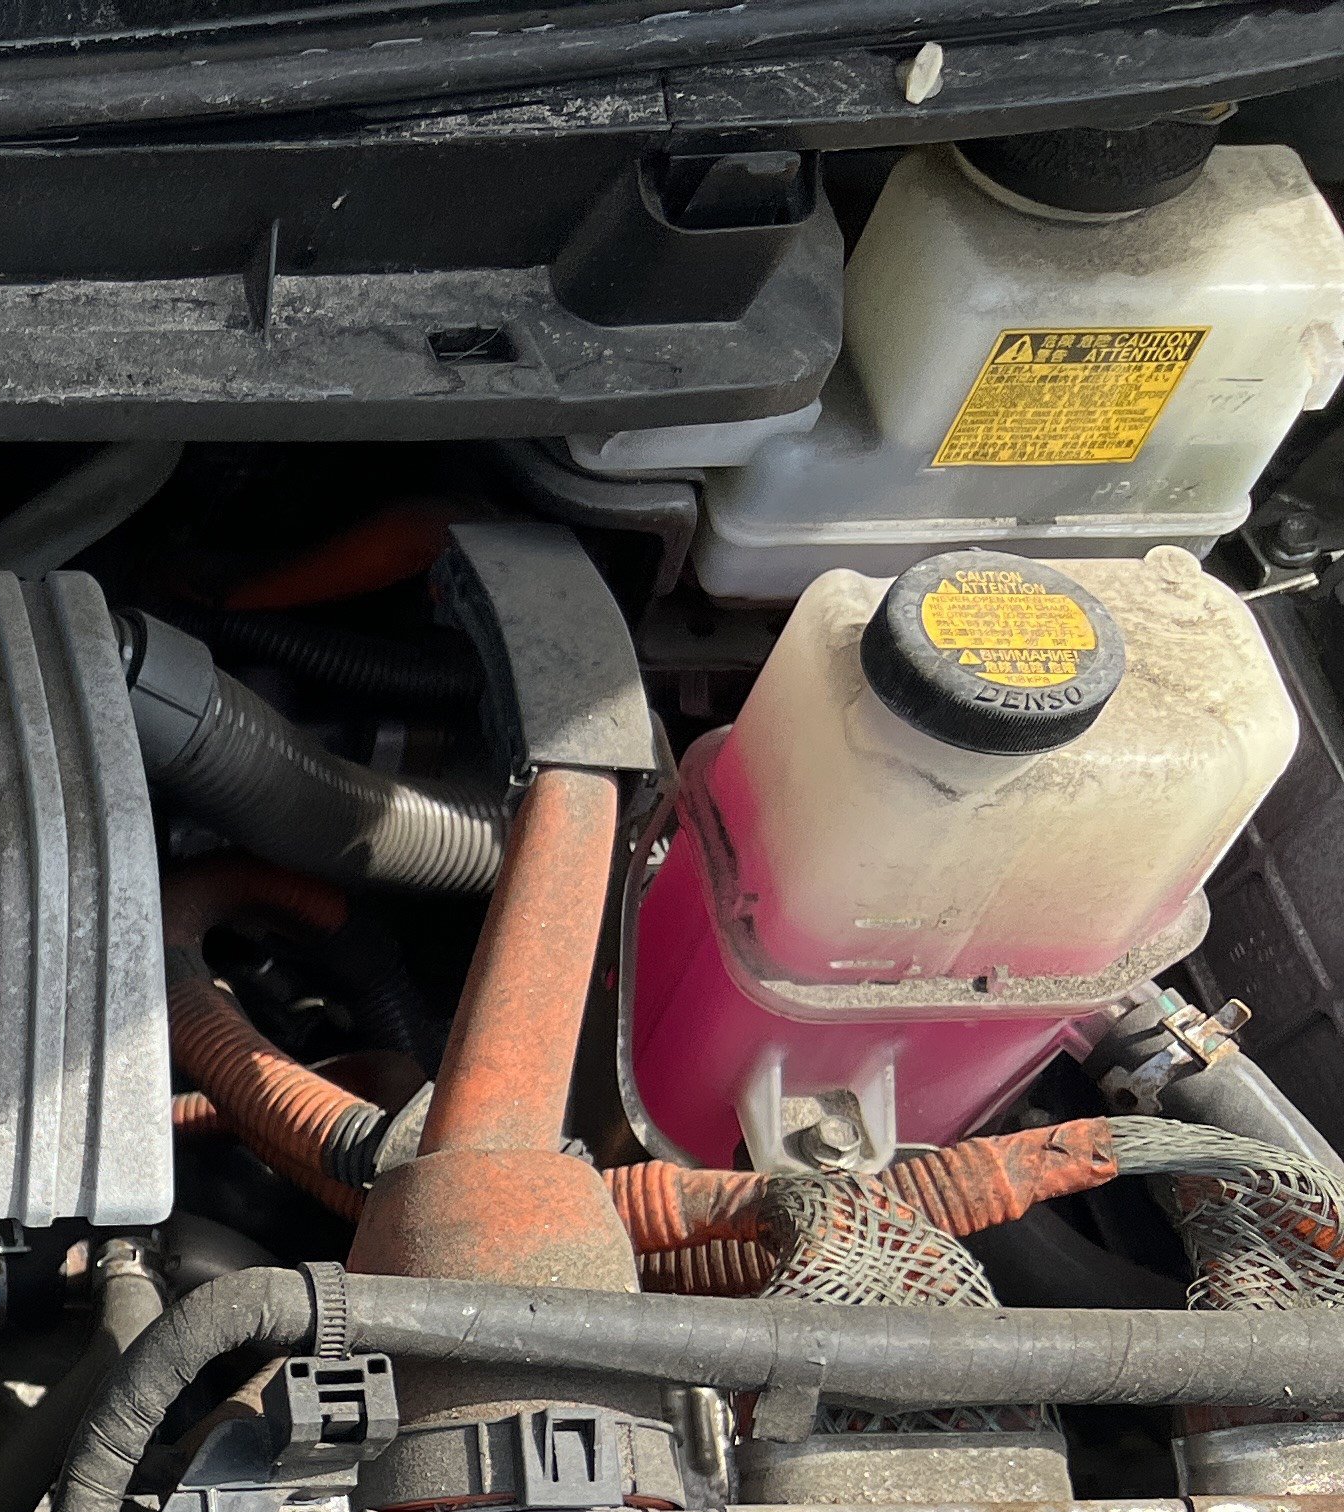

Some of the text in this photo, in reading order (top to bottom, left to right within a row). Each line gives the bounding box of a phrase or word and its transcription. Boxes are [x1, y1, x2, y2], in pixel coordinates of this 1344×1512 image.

[1114, 333, 1196, 347] CAUTION
[1084, 347, 1188, 362] ATTENTION
[956, 571, 1023, 583] CAUTION
[962, 582, 1046, 594] ATTENTION
[980, 650, 1080, 662] ВНИМАНИЕ!
[972, 685, 1084, 711] DENSO
